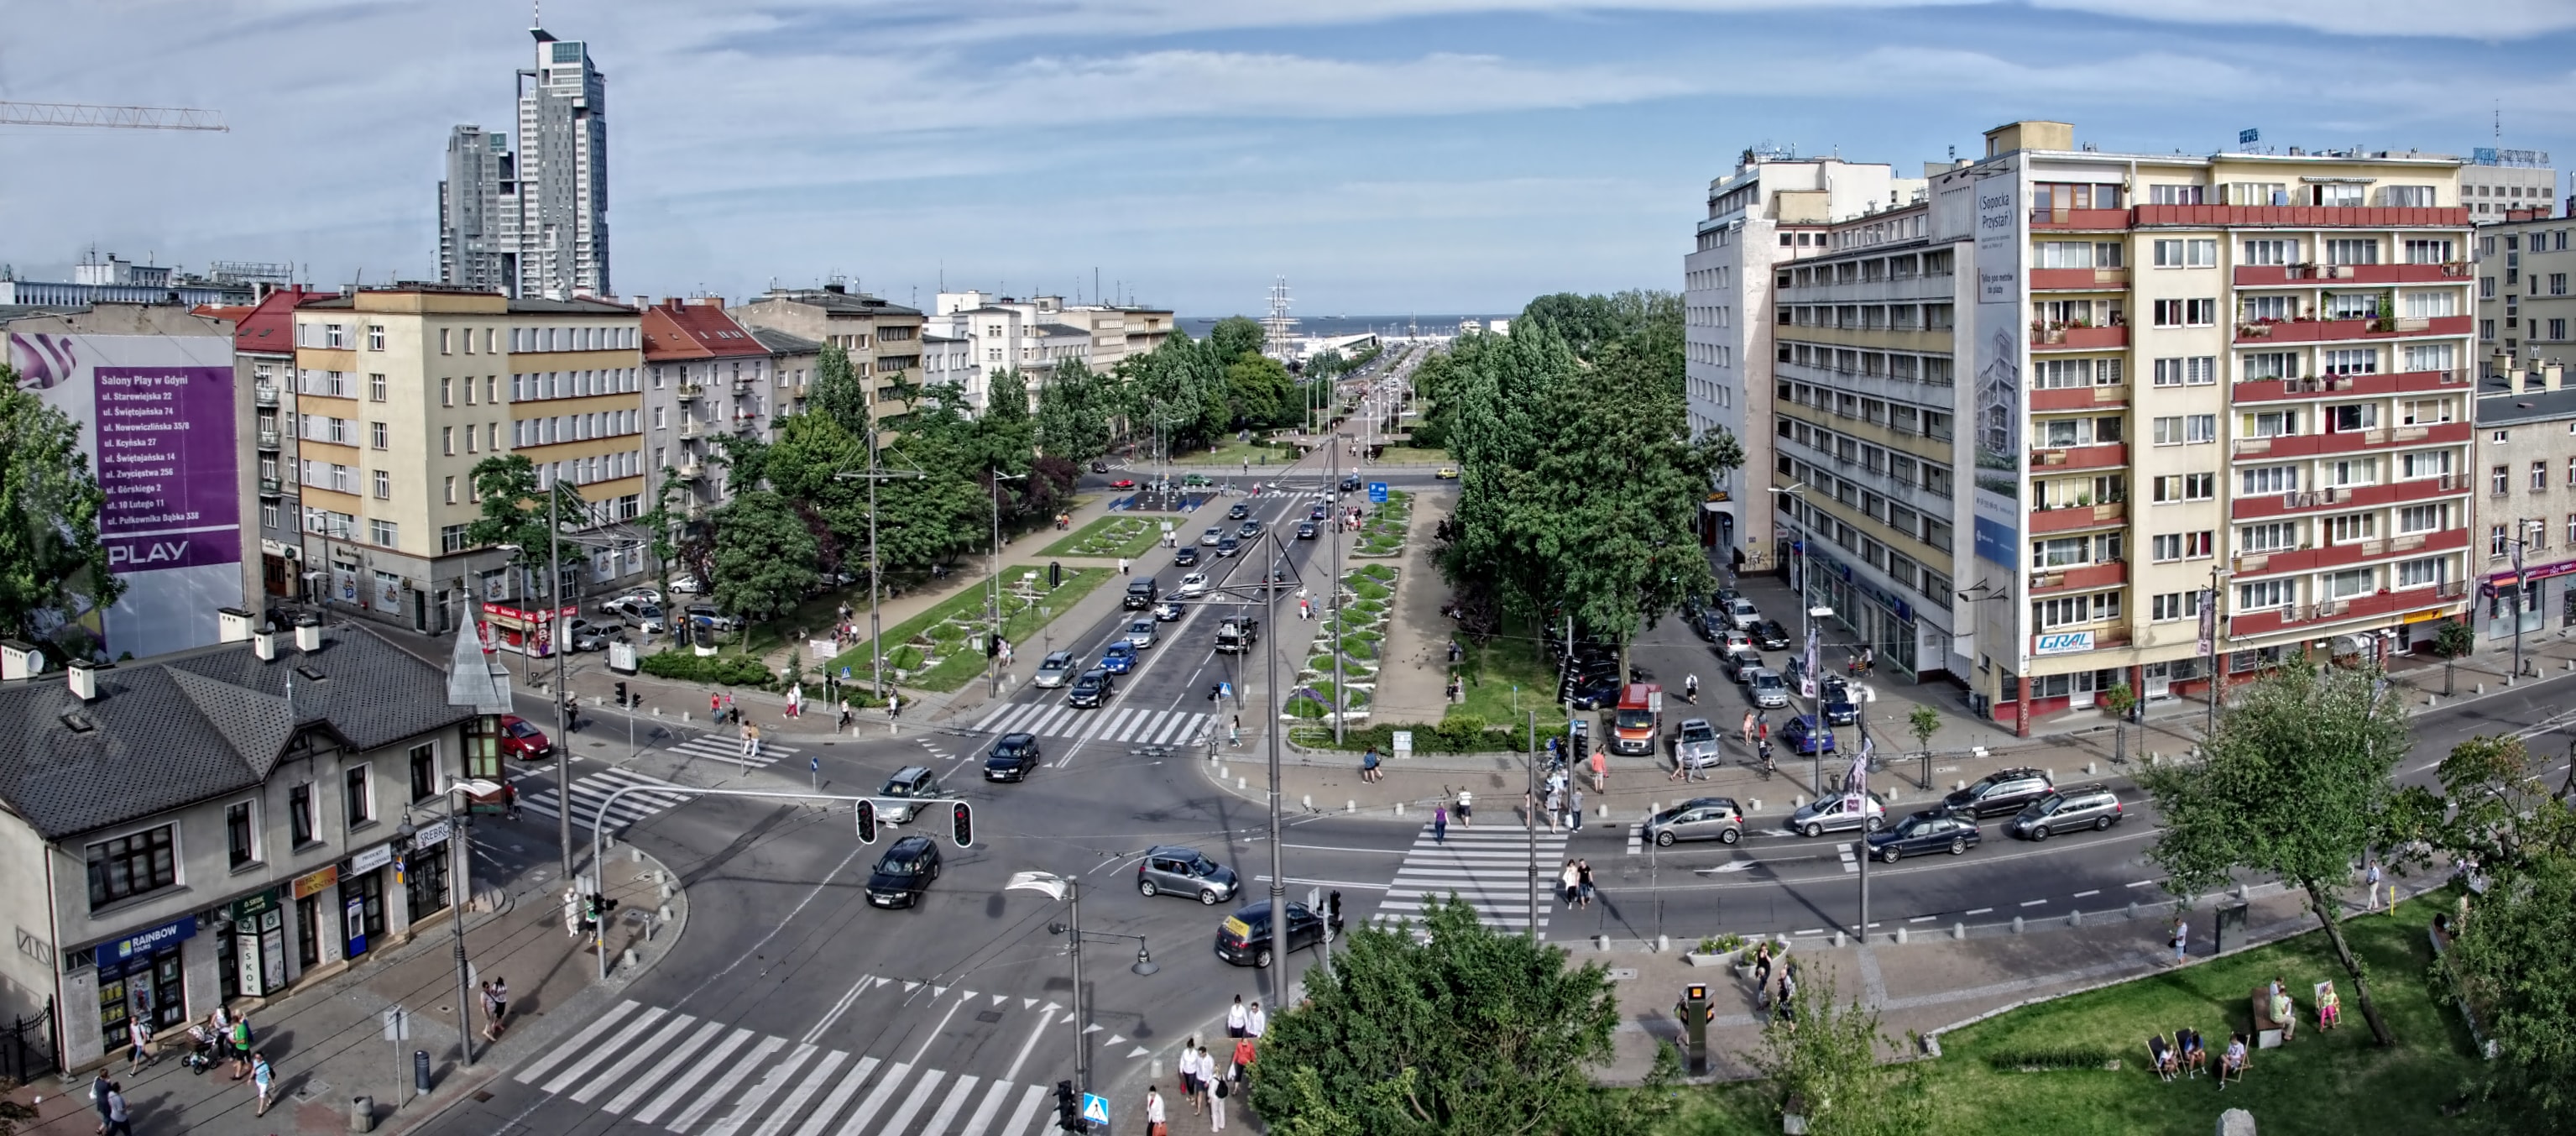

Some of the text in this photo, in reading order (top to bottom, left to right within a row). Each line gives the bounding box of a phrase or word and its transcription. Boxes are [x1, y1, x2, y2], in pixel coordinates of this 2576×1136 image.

[102, 375, 132, 387] Salony
[133, 375, 152, 386] Play
[164, 374, 188, 386] Gdyni
[113, 393, 161, 401] Starowiejska
[163, 392, 172, 400] 22
[114, 406, 163, 417] Świętojańska
[115, 422, 172, 432] Nowowiczlińska
[174, 421, 190, 430] 35/8
[116, 437, 146, 448] Kcyńska
[117, 453, 165, 464] Świętojańska
[117, 469, 159, 479] Zwycięstwa
[159, 468, 173, 476] 256
[118, 484, 155, 495] Górskiego
[129, 500, 154, 510] Lutego
[156, 499, 165, 507] 11
[108, 541, 189, 566] PLAY
[2039, 633, 2091, 649] GRAL
[132, 924, 177, 947] RAINBOW
[133, 944, 151, 953] TOURS
